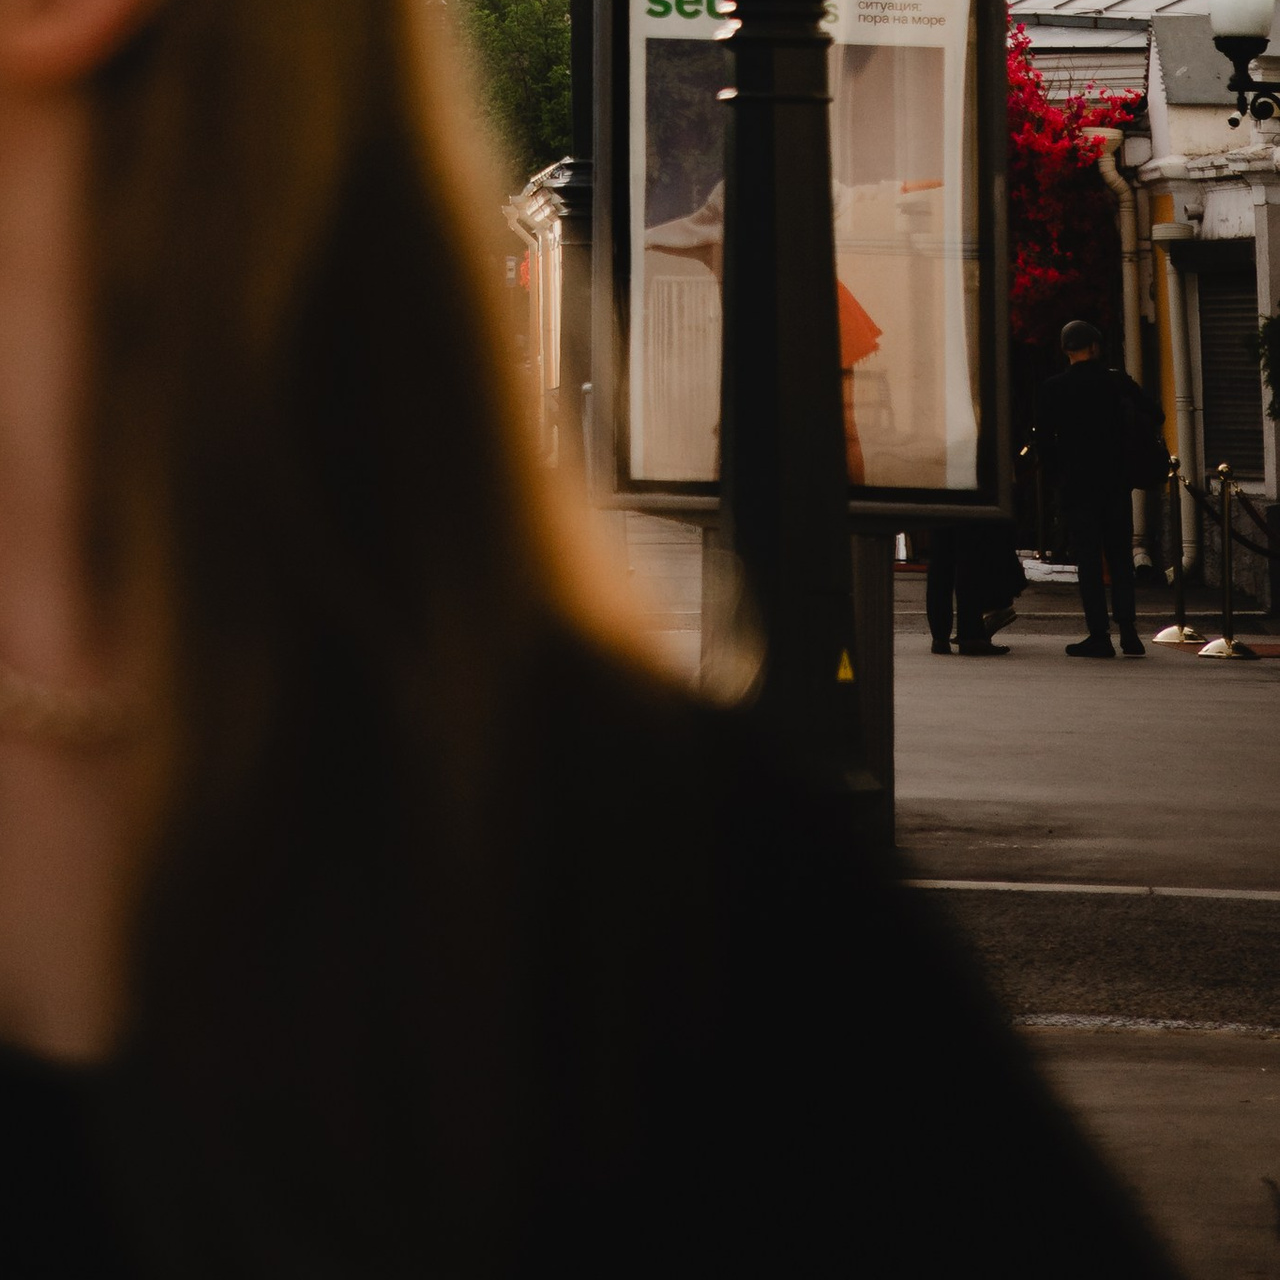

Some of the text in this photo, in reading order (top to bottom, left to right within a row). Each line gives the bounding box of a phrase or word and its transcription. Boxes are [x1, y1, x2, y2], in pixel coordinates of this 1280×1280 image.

[858, 0, 922, 12] ситуация:
[858, 13, 946, 27] пора на море
